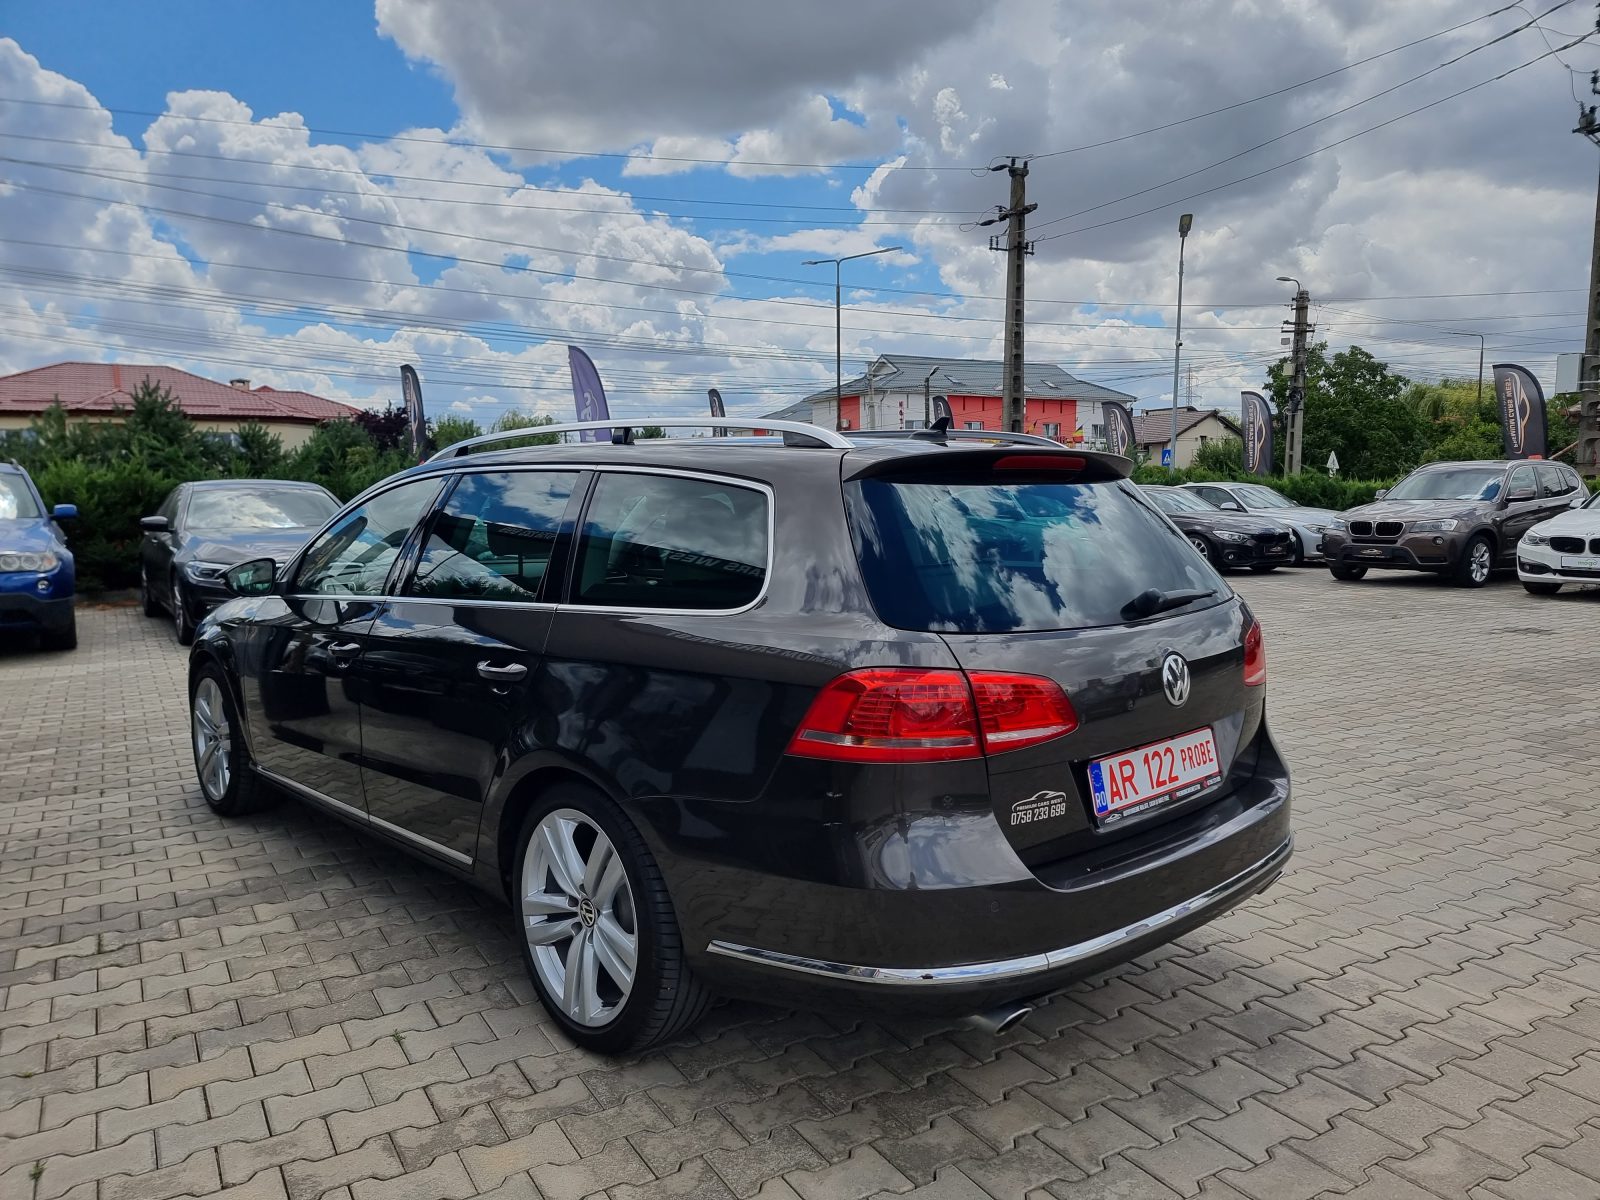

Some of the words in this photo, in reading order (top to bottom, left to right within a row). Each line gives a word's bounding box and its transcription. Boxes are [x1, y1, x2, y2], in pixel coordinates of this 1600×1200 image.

[1109, 759, 1139, 804] AR
[1143, 746, 1179, 790] 122
[1180, 739, 1214, 772] PROBE
[1095, 790, 1107, 808] RO
[1011, 810, 1032, 825] 0758
[1034, 806, 1049, 821] 233
[1050, 803, 1066, 818] 699
